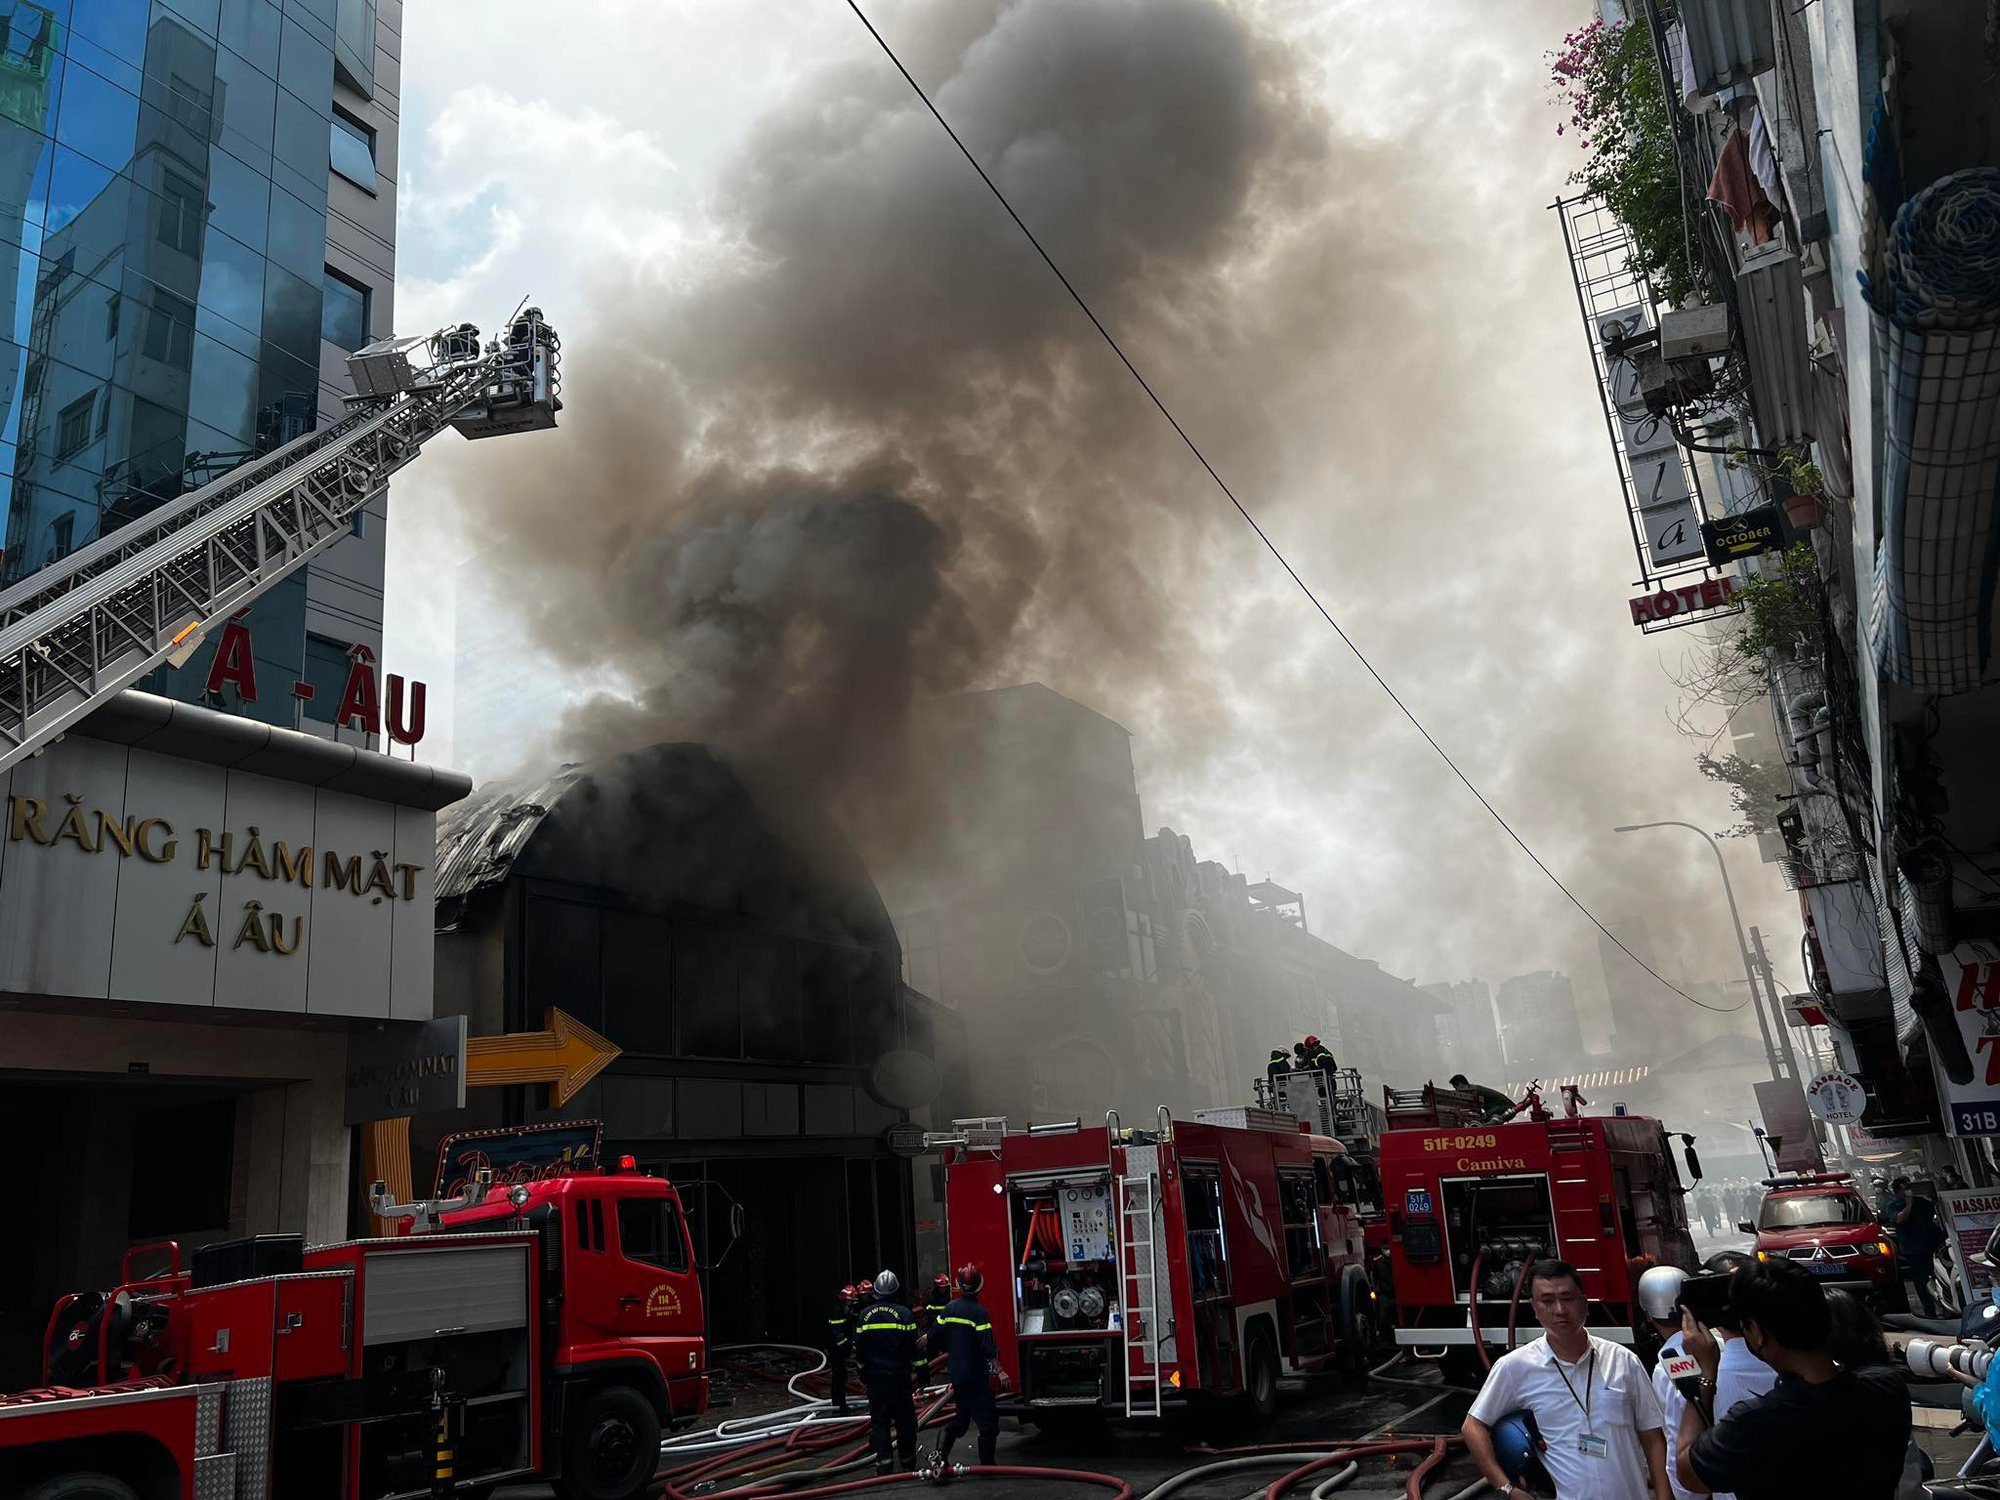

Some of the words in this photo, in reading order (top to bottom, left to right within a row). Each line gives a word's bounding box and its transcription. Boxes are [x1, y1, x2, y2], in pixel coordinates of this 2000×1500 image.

[1715, 527, 1772, 547] OCTOBER
[337, 643, 426, 745] ÂU
[11, 793, 178, 864] RĂNG
[196, 826, 314, 888] HÀM
[324, 850, 425, 904] MẶT
[175, 892, 216, 947] Á
[233, 899, 303, 955] ÂU
[1810, 1075, 1859, 1096] MASSAGE
[1826, 1111, 1855, 1120] HOTEL
[1961, 1111, 1997, 1132] 31B
[1423, 1134, 1497, 1151] 51F-0249
[1456, 1156, 1526, 1172] Camiva
[1408, 1203, 1430, 1212] 0249
[1410, 1195, 1425, 1203] 51F
[1952, 1196, 2000, 1214] MASSAG
[1670, 1359, 1695, 1373] ANTV
